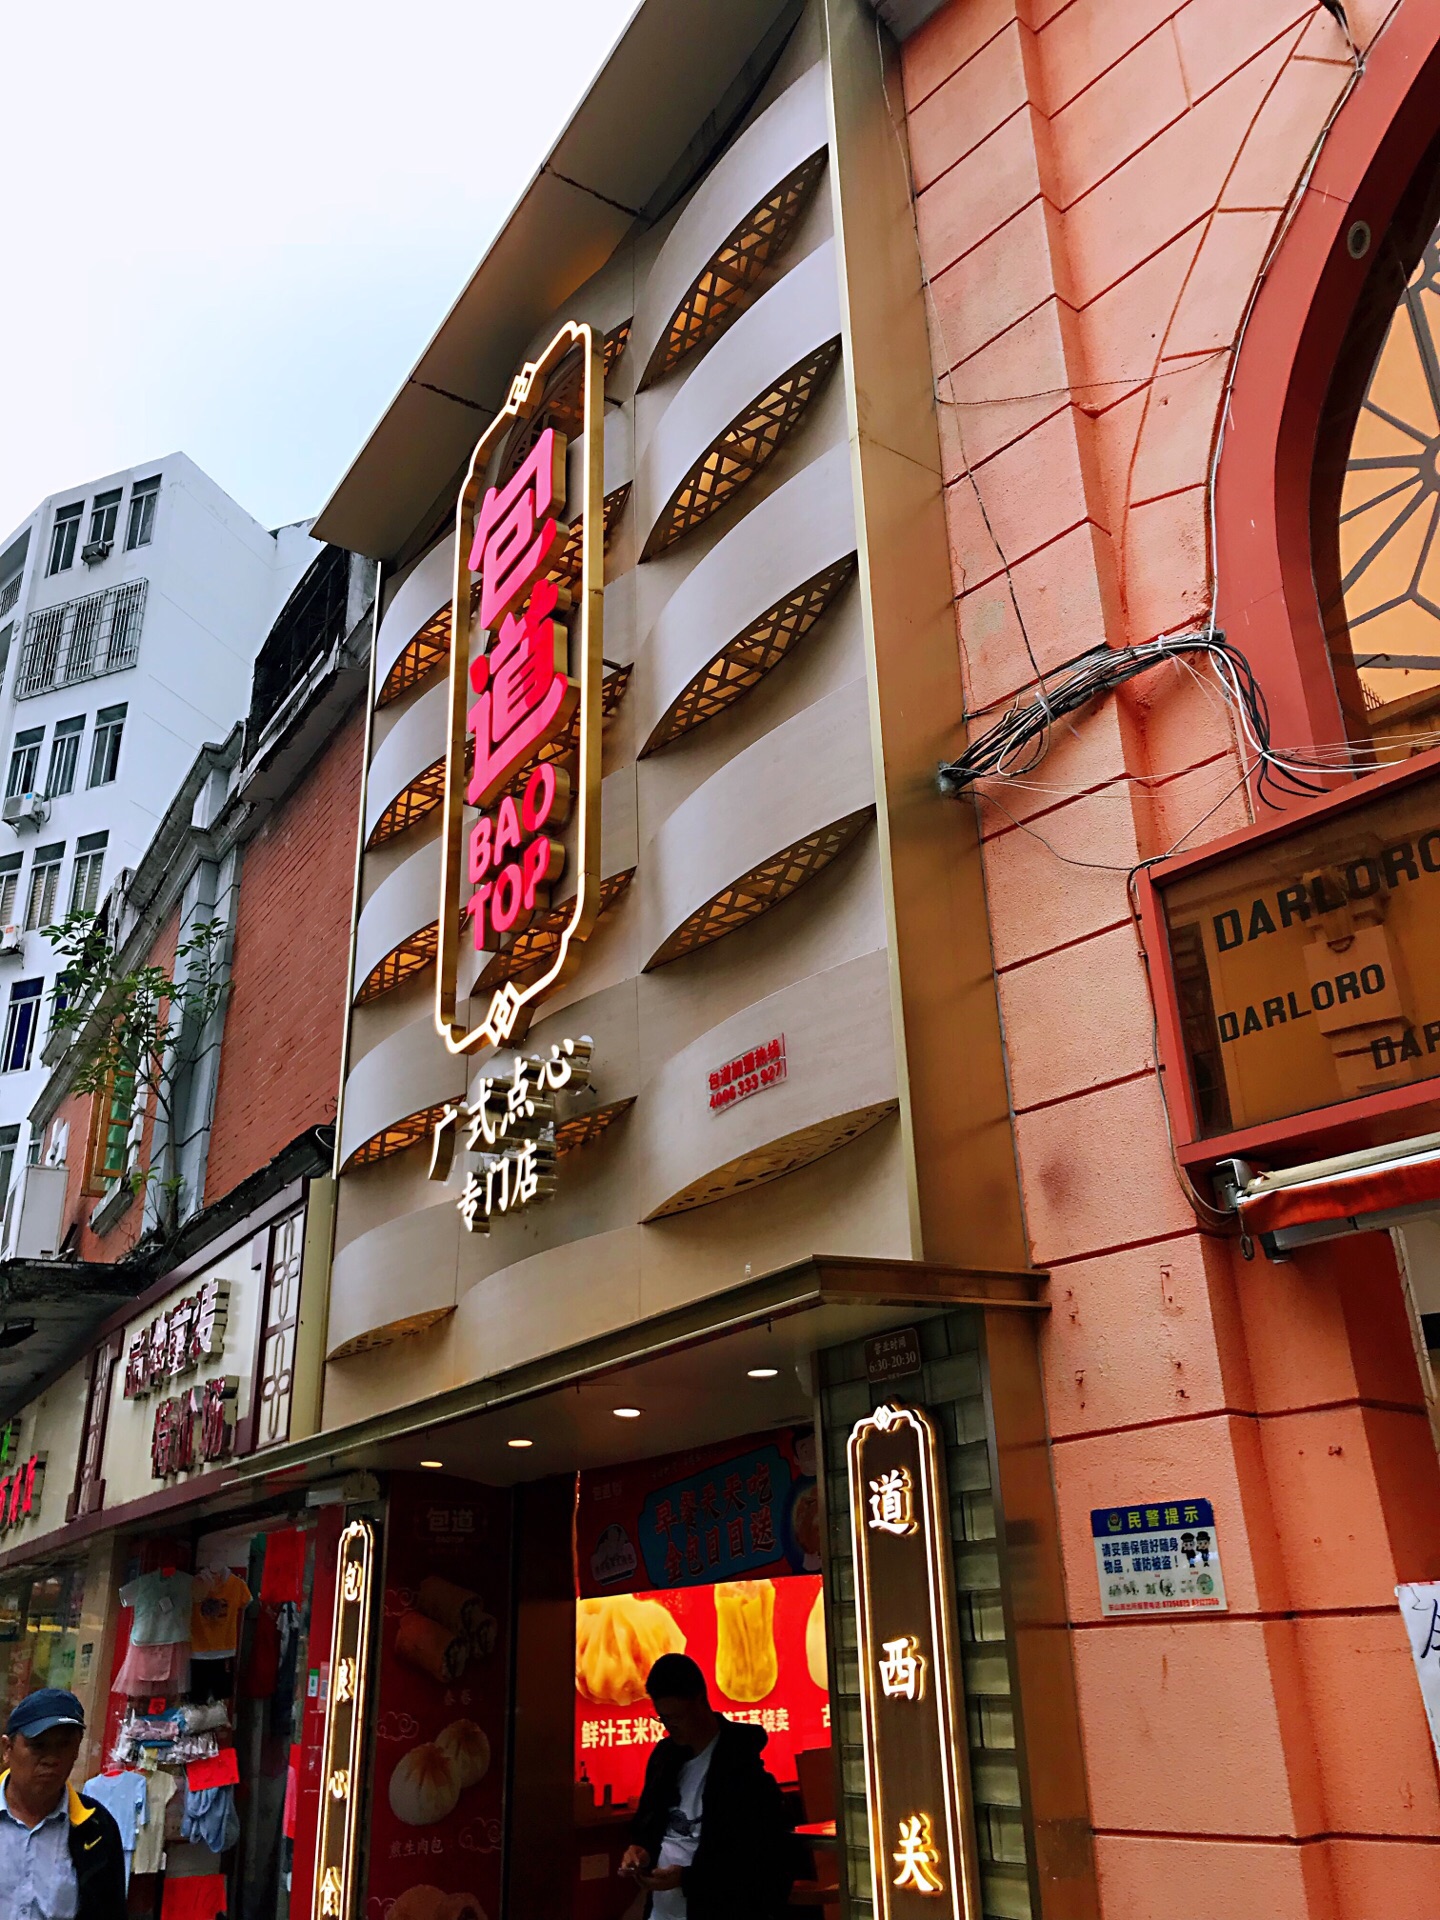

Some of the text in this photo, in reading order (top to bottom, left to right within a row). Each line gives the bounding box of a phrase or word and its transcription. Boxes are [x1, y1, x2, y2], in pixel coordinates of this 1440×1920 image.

[468, 427, 568, 806] 包道
[468, 763, 556, 885] BAO
[466, 835, 551, 952] TOP
[1218, 963, 1386, 1044] DARLORO
[428, 1038, 575, 1181] 广式点心
[737, 1073, 759, 1096] 333
[455, 1138, 538, 1233] 专门店
[425, 1506, 477, 1534] 包道
[1101, 1537, 1180, 1558] 请妥善保管好随身
[1127, 1506, 1200, 1529] 民警提示
